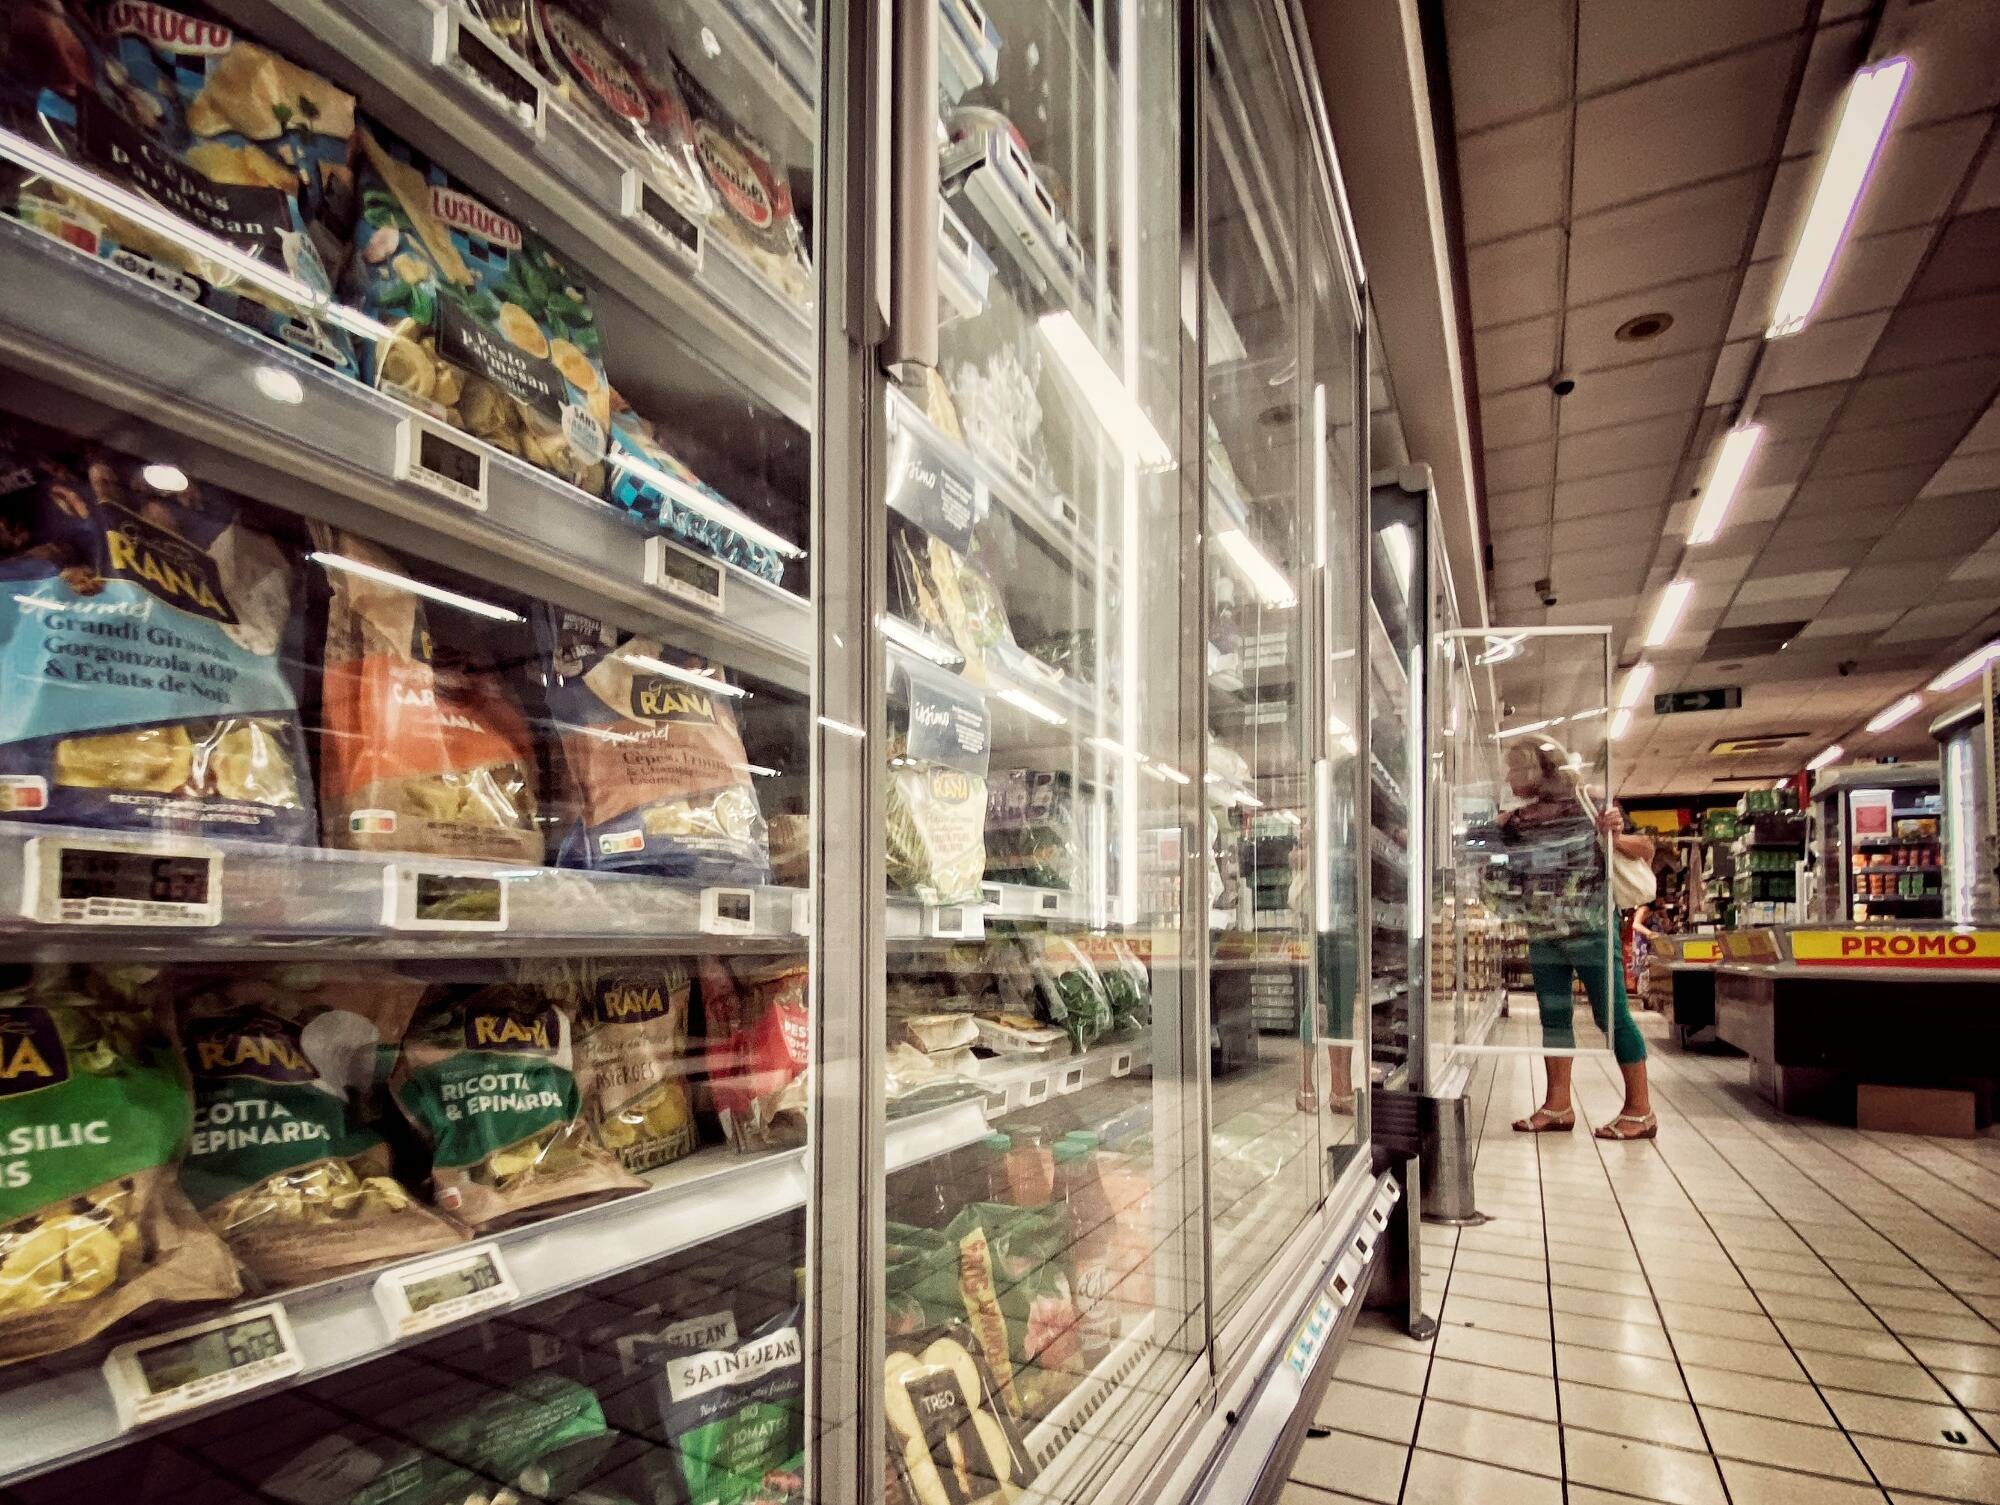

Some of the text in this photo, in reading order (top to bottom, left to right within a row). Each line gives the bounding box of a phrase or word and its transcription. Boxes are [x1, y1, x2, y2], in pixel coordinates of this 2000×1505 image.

[106, 529, 229, 618] RANA
[45, 614, 139, 641] Grandi
[45, 636, 191, 672] Gorgonzola
[44, 658, 66, 677] &
[159, 675, 187, 692] de
[1841, 935, 1976, 956] PROMO
[604, 988, 664, 1017] RANA
[198, 1033, 313, 1073] RANA
[441, 1073, 530, 1101] RICOTTA
[446, 1103, 462, 1121] &
